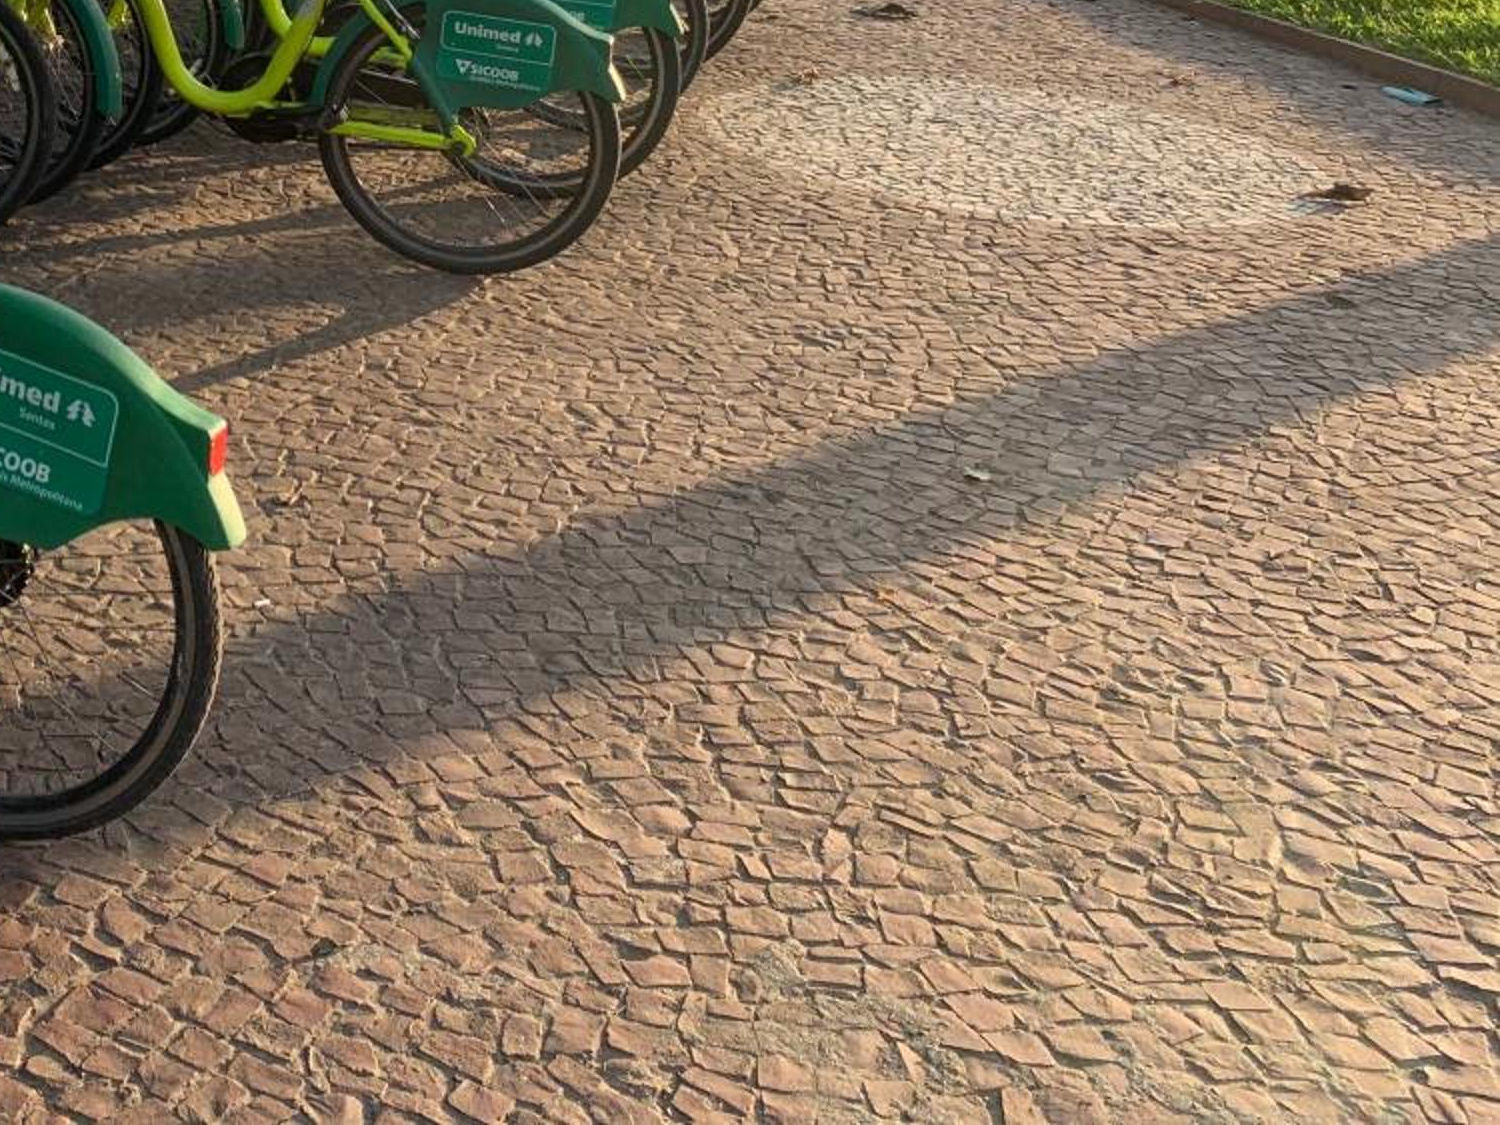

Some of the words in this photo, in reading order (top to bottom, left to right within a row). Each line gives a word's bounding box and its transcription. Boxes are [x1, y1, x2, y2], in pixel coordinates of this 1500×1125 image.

[454, 21, 521, 44] Unimed
[470, 64, 520, 82] SICOOB
[19, 407, 56, 430] Santos
[10, 473, 83, 511] Metropolitana
